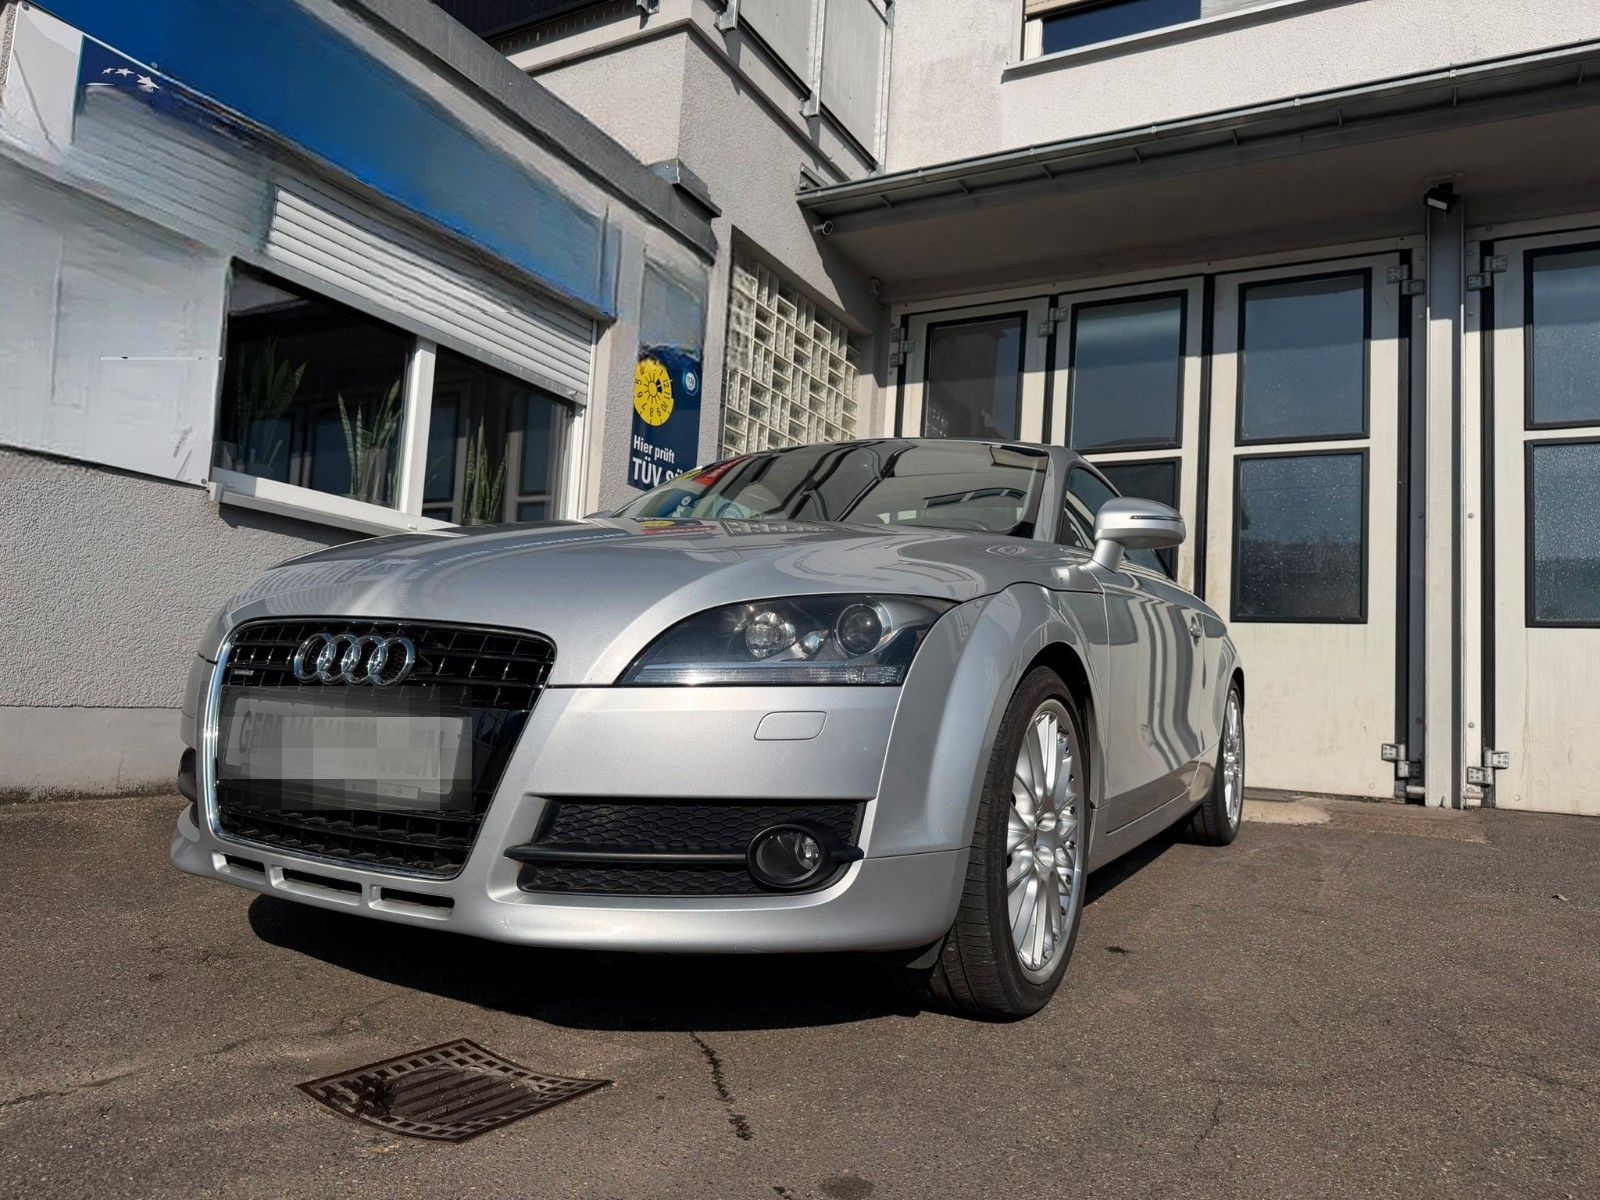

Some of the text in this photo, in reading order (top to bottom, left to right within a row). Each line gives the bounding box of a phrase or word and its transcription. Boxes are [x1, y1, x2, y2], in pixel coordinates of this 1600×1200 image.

[633, 434, 675, 464] Hier prüft
[632, 456, 663, 487] TÜV
